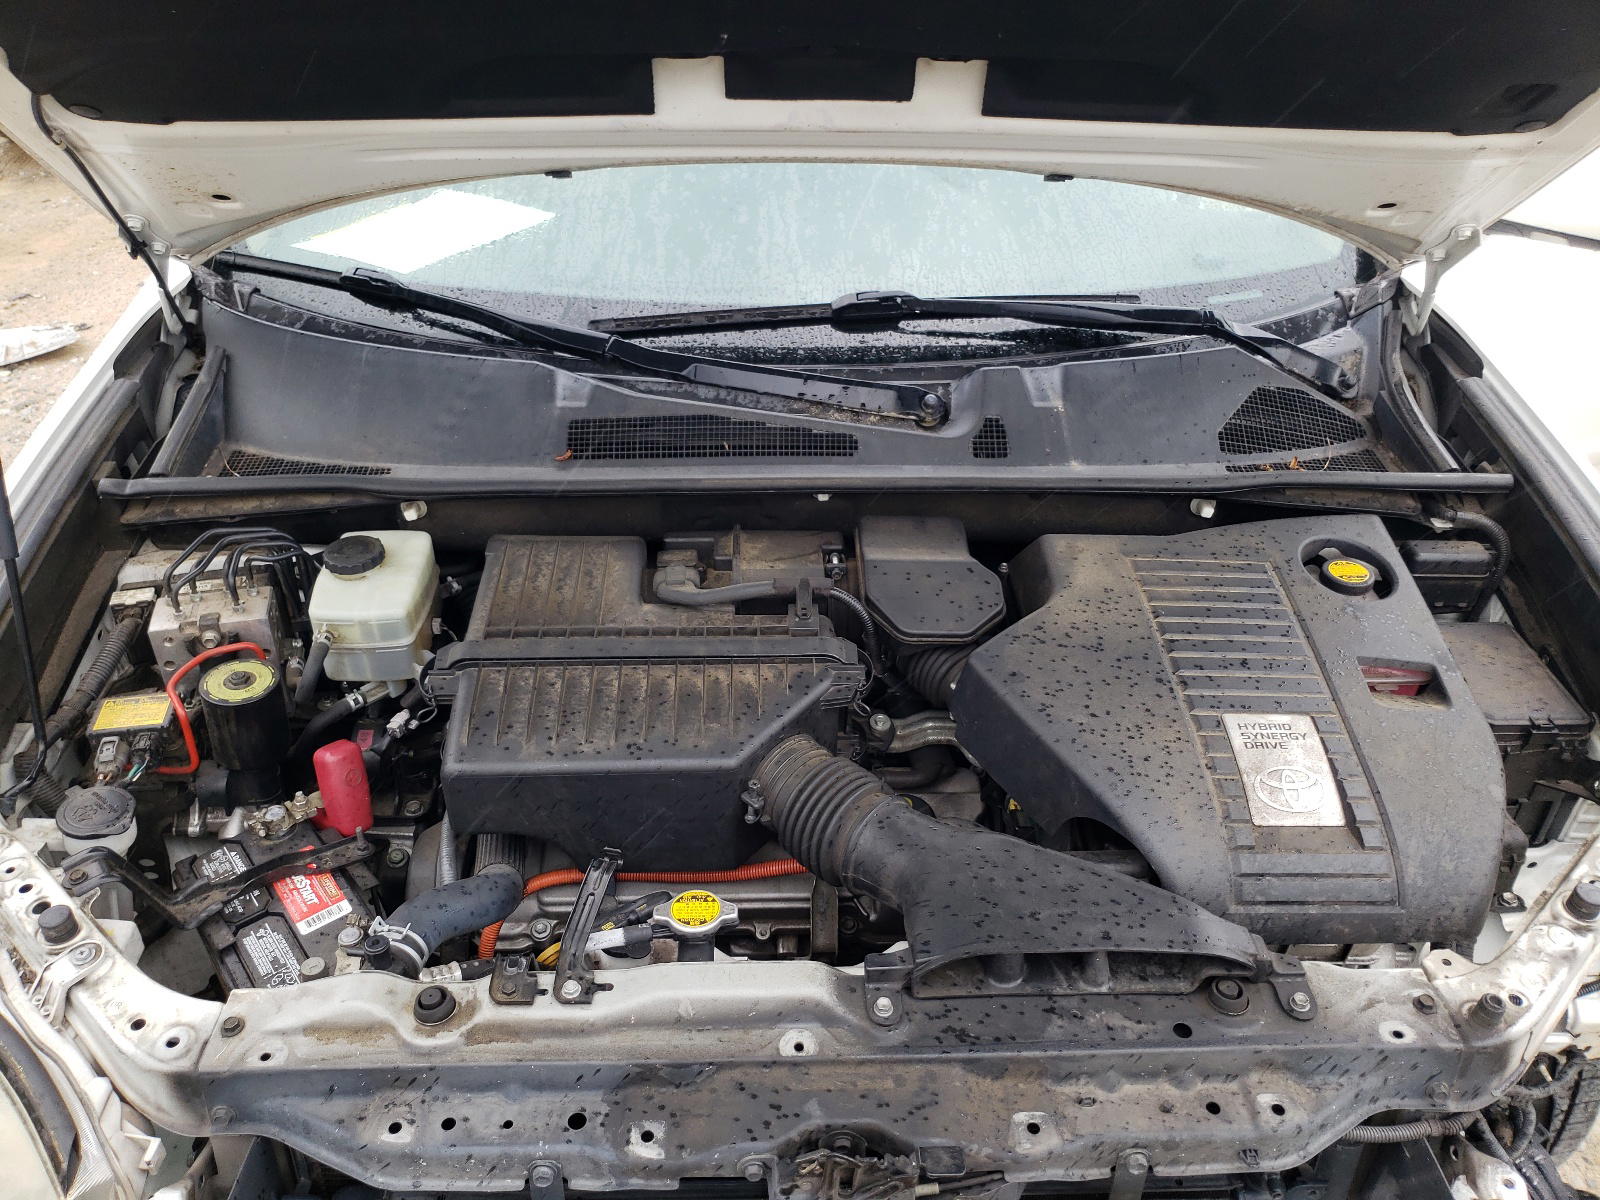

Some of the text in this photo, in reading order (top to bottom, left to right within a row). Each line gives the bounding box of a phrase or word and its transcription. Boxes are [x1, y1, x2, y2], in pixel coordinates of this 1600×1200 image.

[1237, 722, 1292, 731] HYBRID
[1240, 732, 1308, 741] SYNERGY
[1244, 741, 1289, 750] DRIVE
